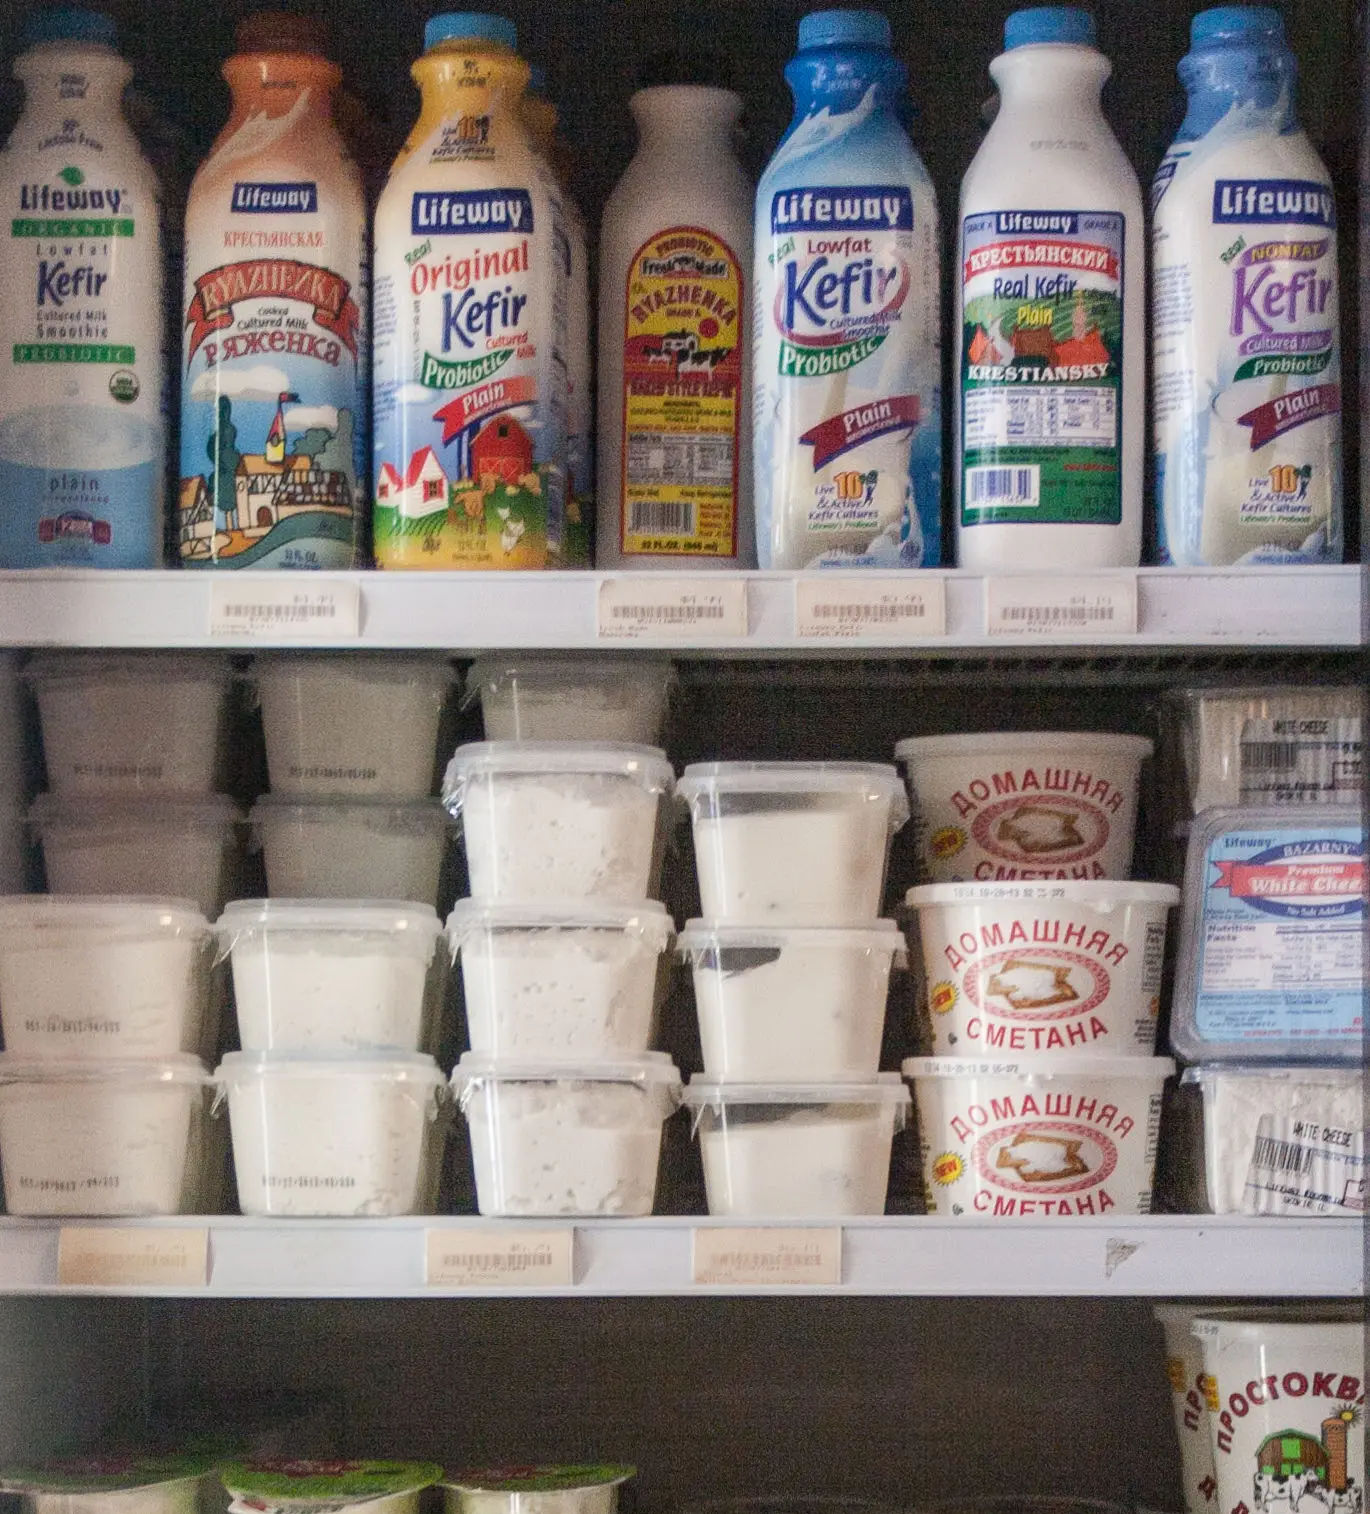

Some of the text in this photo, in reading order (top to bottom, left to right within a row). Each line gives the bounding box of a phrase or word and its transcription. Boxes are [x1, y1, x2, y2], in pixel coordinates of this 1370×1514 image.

[21, 184, 121, 213] Lifeway
[236, 187, 311, 210] Lifeway
[418, 198, 522, 227] Lifeway
[777, 193, 900, 225] Lifeway
[1221, 186, 1332, 222] Lifeway
[999, 213, 1072, 232] Lifeway
[37, 242, 108, 256] Lowfat
[808, 237, 872, 257] Lowfat
[1251, 243, 1320, 262] NONFAT
[411, 240, 529, 295] Original
[37, 261, 107, 306] Kefir
[785, 256, 897, 330] Kefir
[994, 273, 1078, 306] Real Kefir
[1017, 304, 1053, 325] Plain
[1230, 265, 1333, 337] Kefir
[442, 285, 528, 351] Kefir
[424, 350, 505, 387] Probiotic
[781, 338, 878, 375] Probiotic
[968, 363, 1110, 382] KRESTIANSKY
[463, 382, 505, 415] Plain
[1273, 389, 1320, 420] Plain
[842, 402, 892, 433] Plain
[50, 472, 99, 493] plain
[833, 471, 864, 499] 10
[1268, 465, 1298, 493] 10
[951, 768, 1124, 818] ДОМАШНЯЯ
[1225, 837, 1272, 848] Lifeway
[1284, 842, 1350, 857] BAZARNY
[974, 861, 1108, 881] СМЕТАНА
[1251, 876, 1362, 893] White Chee
[1288, 865, 1344, 876] Premium
[943, 919, 1129, 972] ДОМАШНЯЯ
[967, 1016, 1109, 1050] СМЕТАНА
[950, 1093, 1134, 1144] ДОМАШНЯЯ
[1293, 1122, 1319, 1139] WHITE
[974, 1188, 1115, 1216] СМЕТАНА
[1217, 1372, 1364, 1454] ПРОСТОКВ
